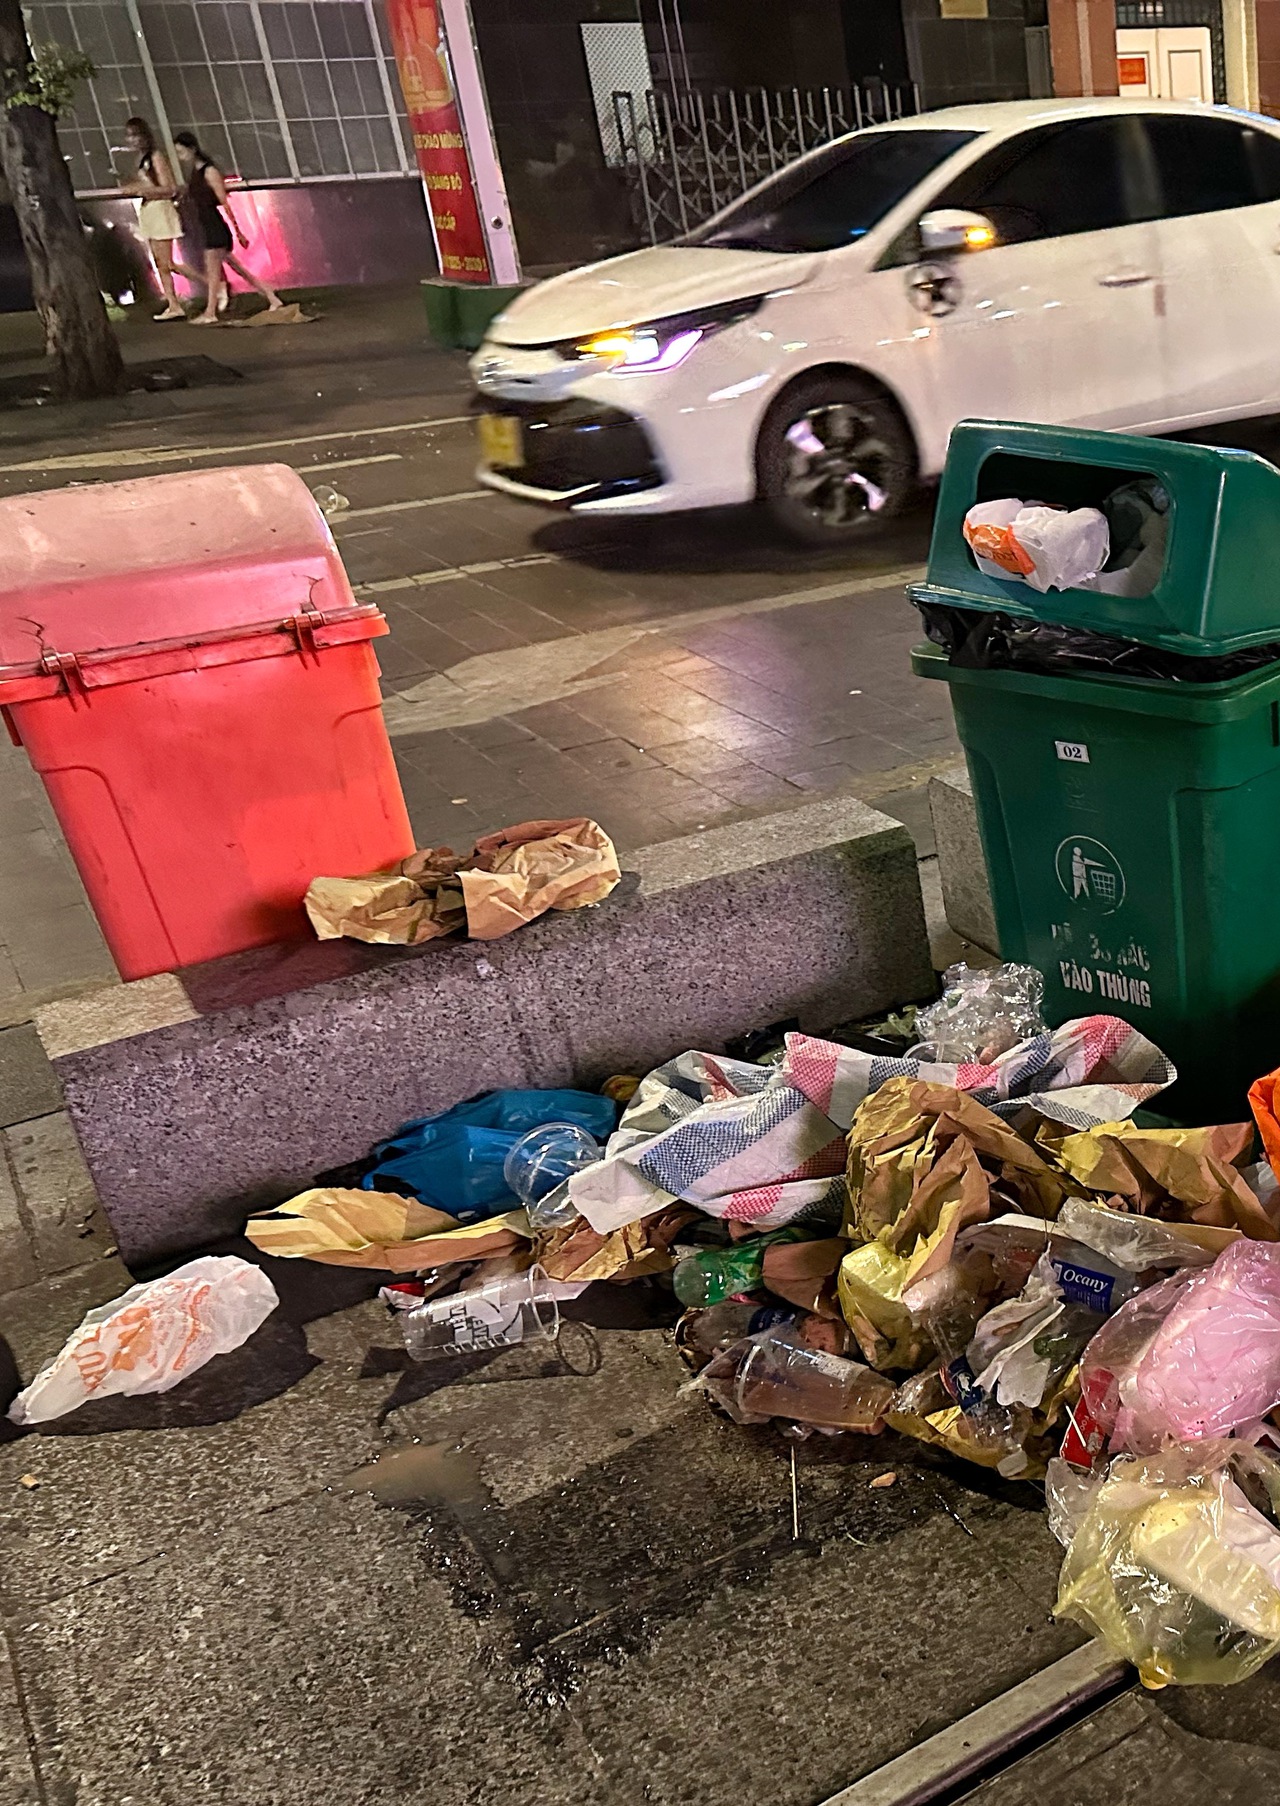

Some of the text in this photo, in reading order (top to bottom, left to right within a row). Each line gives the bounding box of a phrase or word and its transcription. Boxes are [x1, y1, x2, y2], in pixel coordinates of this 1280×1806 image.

[1064, 746, 1082, 759] 02
[1060, 959, 1152, 1008] VÀO THÙNG
[1064, 1269, 1108, 1292] Ocany
